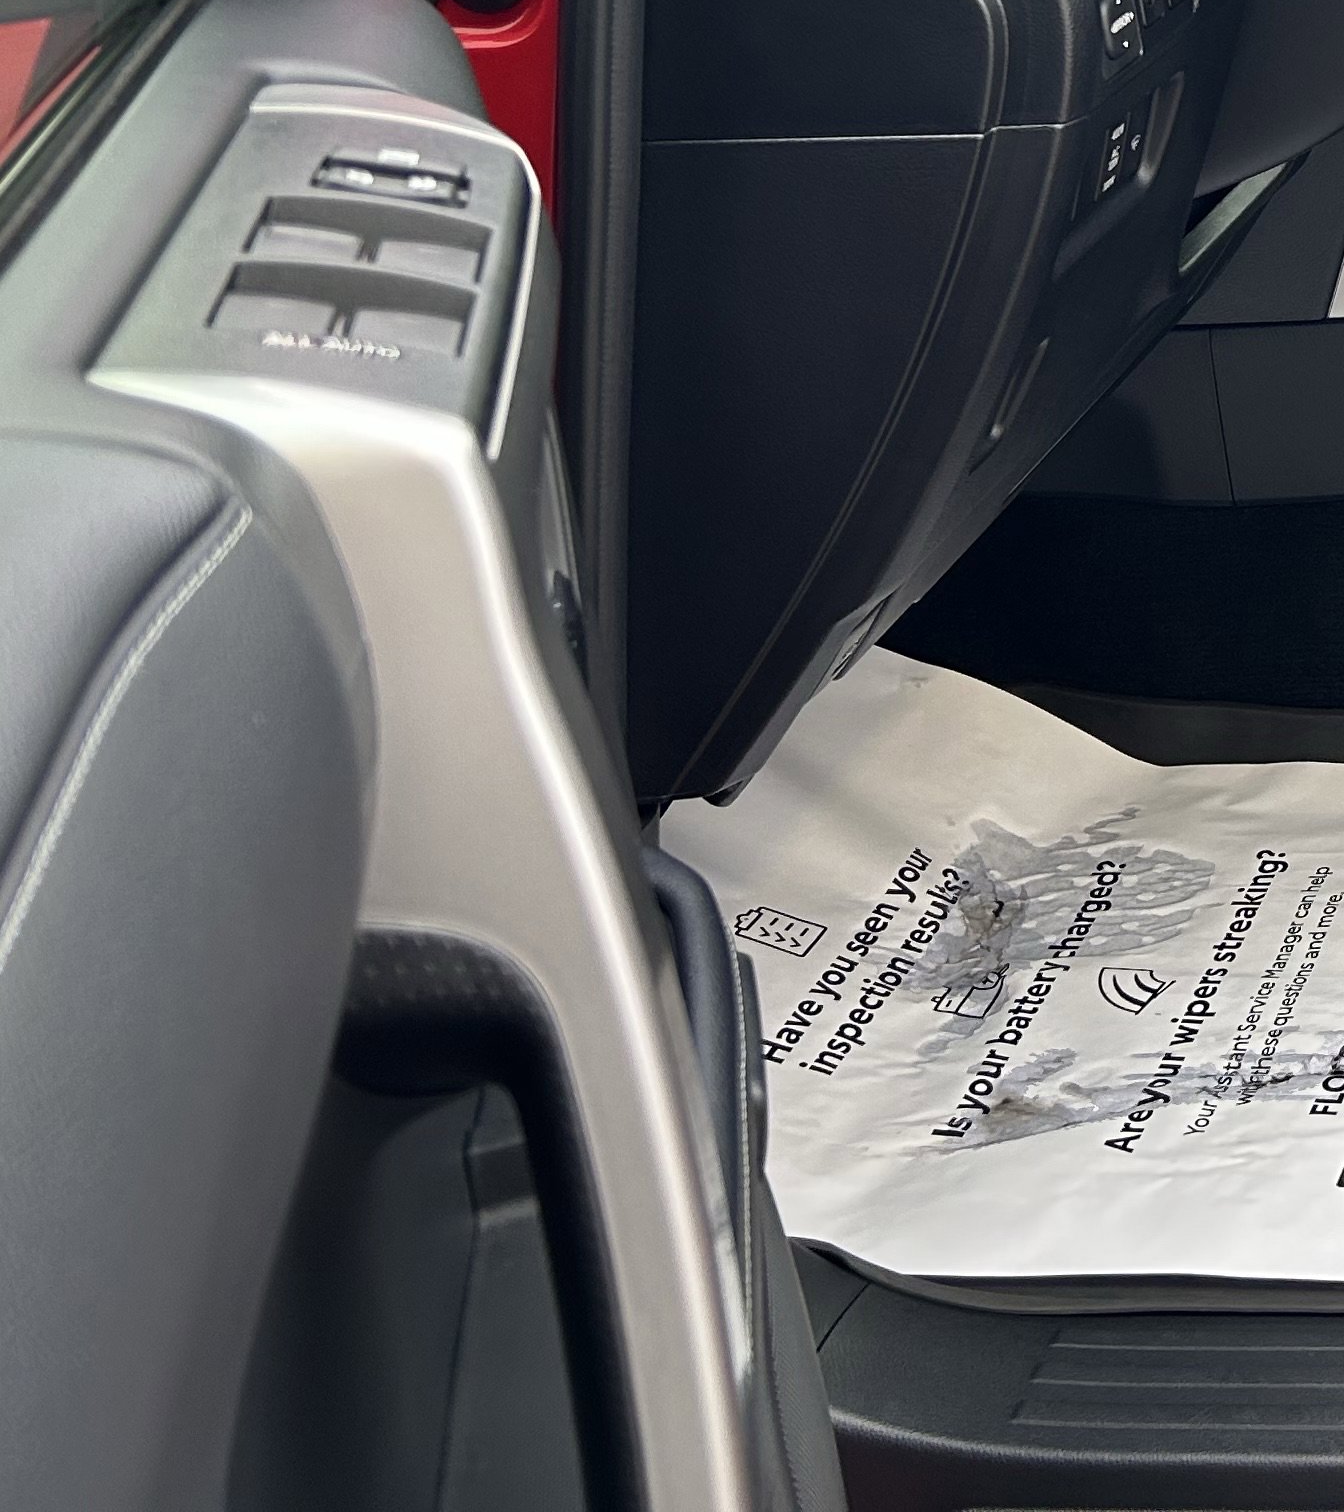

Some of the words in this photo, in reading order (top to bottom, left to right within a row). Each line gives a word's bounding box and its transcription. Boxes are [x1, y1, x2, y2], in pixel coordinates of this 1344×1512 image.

[1295, 894, 1317, 919] can
[1301, 866, 1334, 893] help
[761, 999, 823, 1064] Have
[809, 955, 859, 1001] you
[846, 902, 900, 957] seen
[885, 847, 932, 903] your
[799, 956, 915, 1076] inspection
[901, 868, 970, 954] results?
[931, 1117, 972, 1138] Is
[957, 1049, 1010, 1115] your
[985, 961, 1070, 1045] battery
[1048, 860, 1127, 960] charged?
[1104, 1109, 1153, 1153] Are
[1136, 1052, 1186, 1107] your
[1169, 967, 1228, 1047] wipers
[1213, 849, 1289, 963] streaking?
[1238, 981, 1276, 1032] Service
[1251, 1029, 1282, 1077] these
[1274, 962, 1314, 1027] questions
[1306, 931, 1327, 959] and
[1317, 892, 1344, 927] more.
[1261, 921, 1302, 979] Manager
[1183, 1099, 1218, 1136] Your
